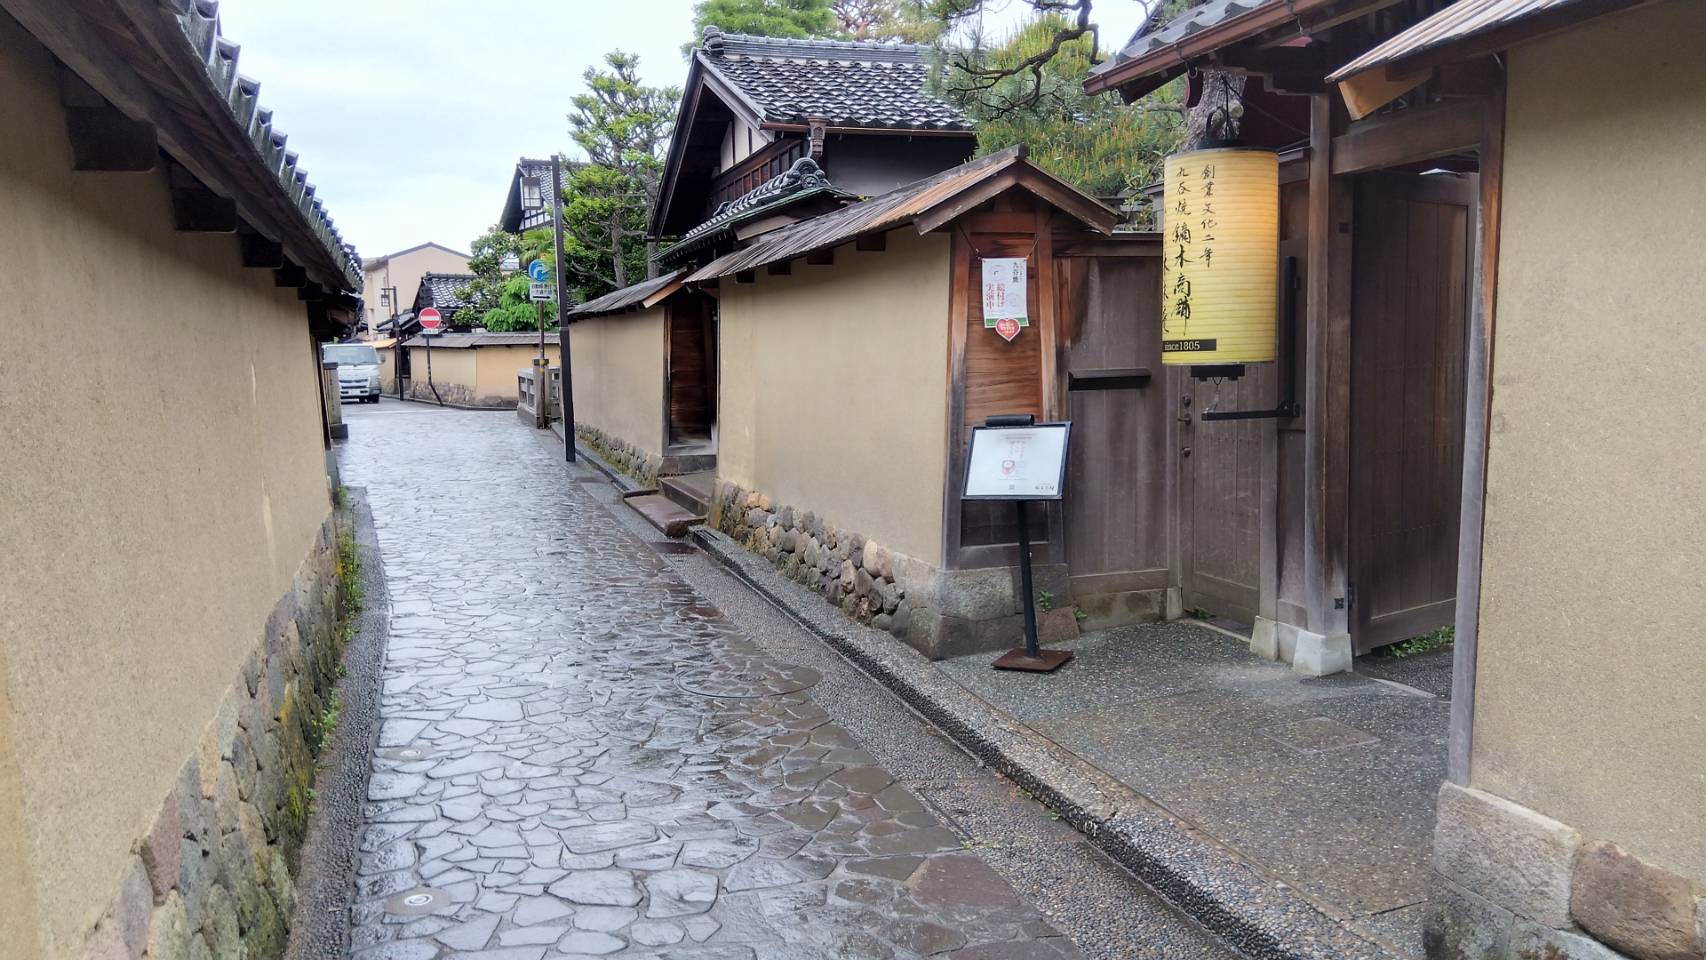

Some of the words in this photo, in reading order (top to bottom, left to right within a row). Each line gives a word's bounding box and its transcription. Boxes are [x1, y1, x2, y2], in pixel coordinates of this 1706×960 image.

[1199, 164, 1218, 268] 創業文化二年
